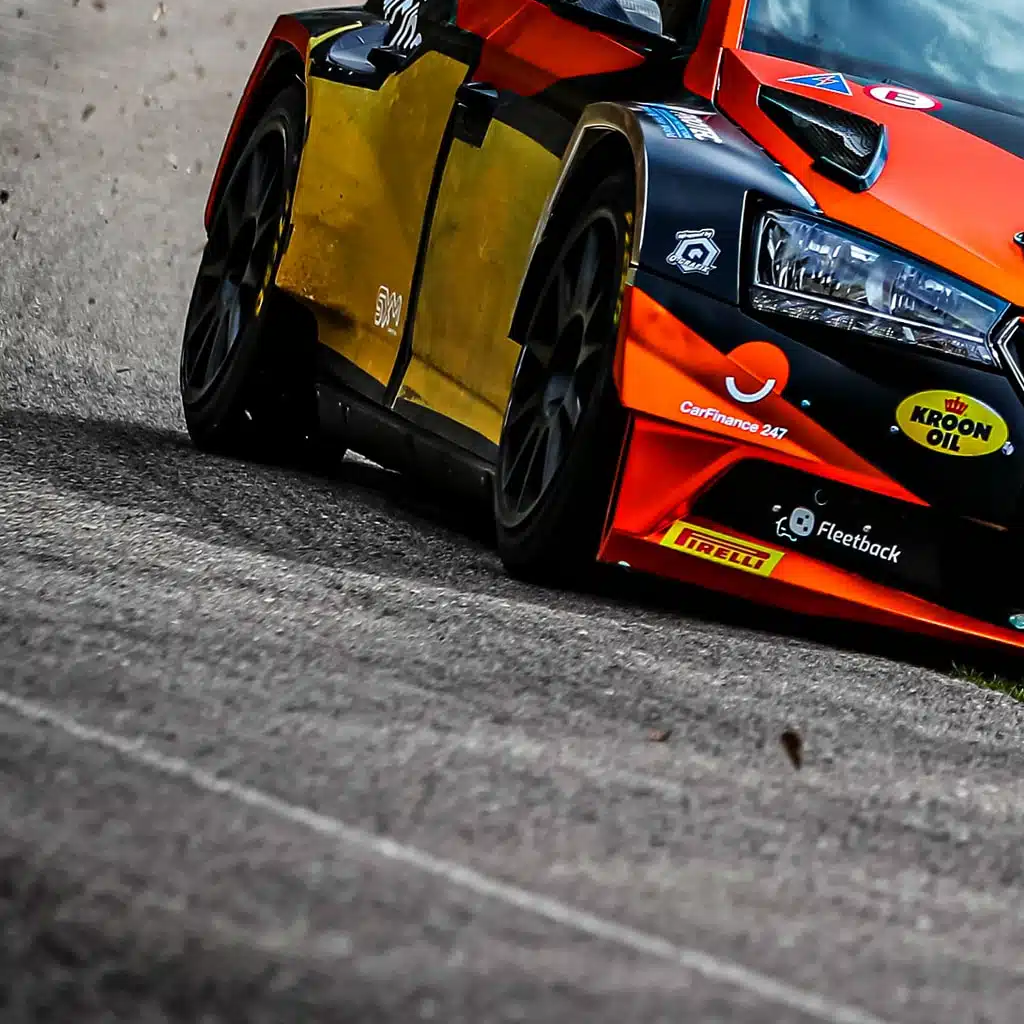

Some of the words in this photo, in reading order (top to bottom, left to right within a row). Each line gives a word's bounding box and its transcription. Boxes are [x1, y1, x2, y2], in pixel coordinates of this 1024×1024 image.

[679, 400, 760, 433] CarFinance
[760, 423, 788, 440] 247
[909, 405, 992, 442] KROON
[926, 429, 960, 452] OIL
[674, 527, 771, 570] PIRELLI
[816, 520, 902, 563] Fleetback
